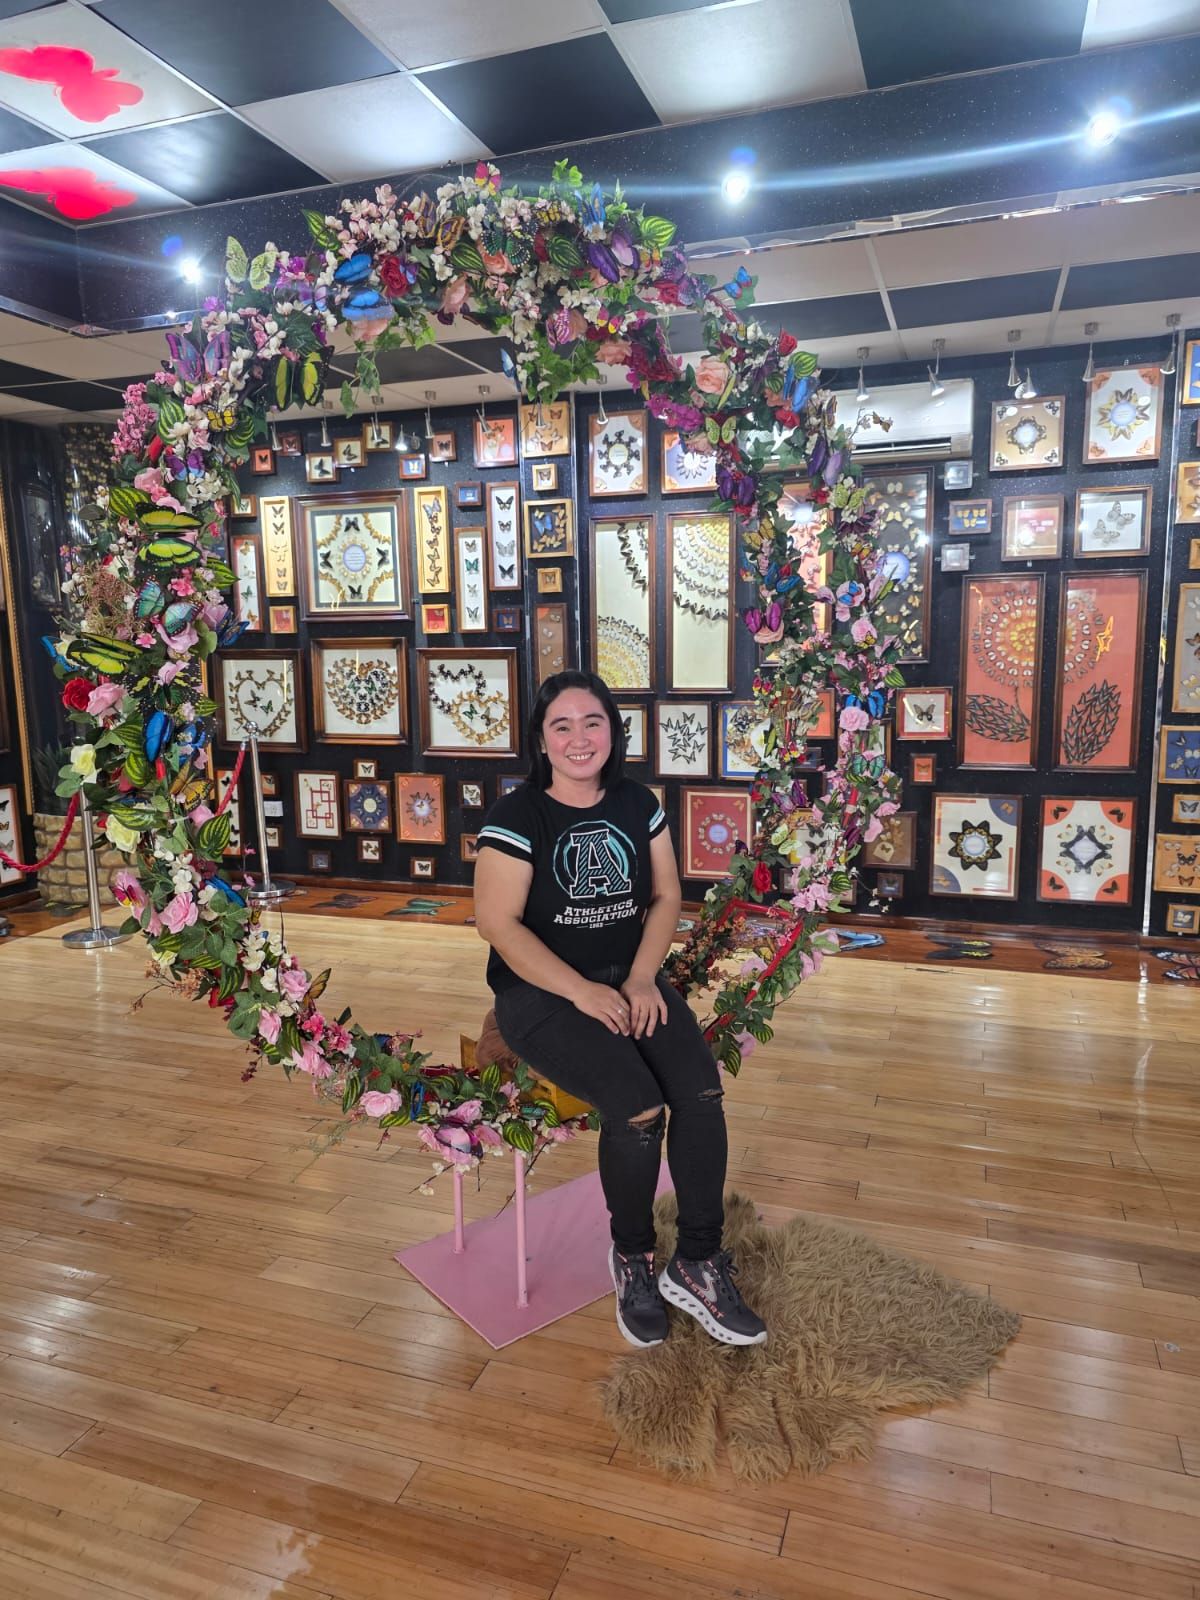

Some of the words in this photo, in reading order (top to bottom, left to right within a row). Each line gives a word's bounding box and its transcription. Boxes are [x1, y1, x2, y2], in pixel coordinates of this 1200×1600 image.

[570, 829, 631, 898] A
[554, 906, 638, 925] ASSOCIATION
[564, 899, 634, 917] ATHLETICS
